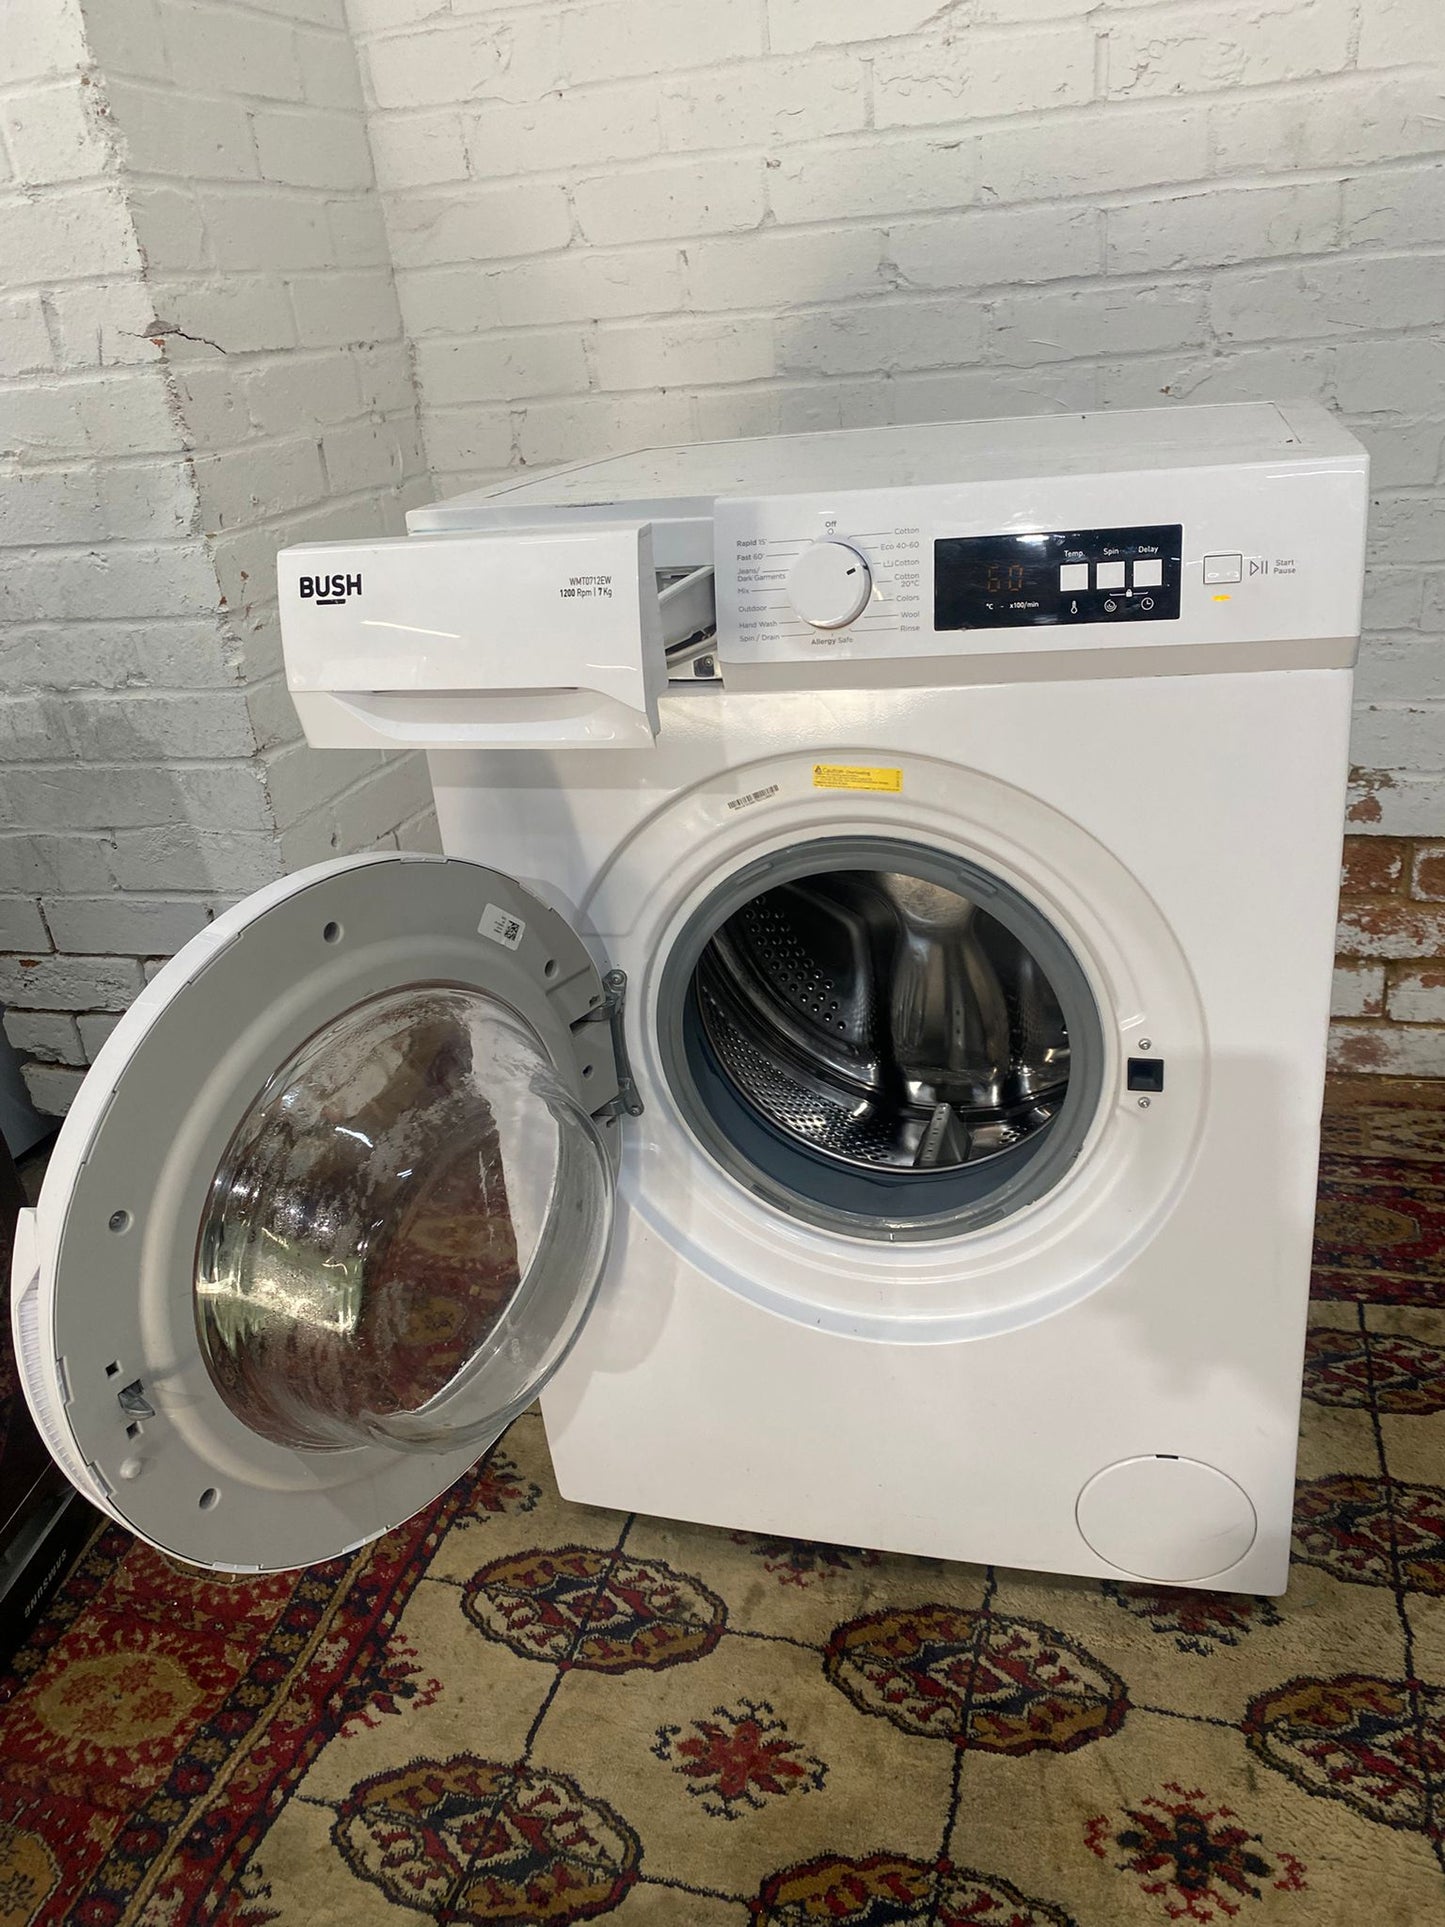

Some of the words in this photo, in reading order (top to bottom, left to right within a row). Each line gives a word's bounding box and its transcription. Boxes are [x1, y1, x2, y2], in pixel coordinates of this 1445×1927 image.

[825, 520, 837, 528] Off
[736, 539, 757, 548] Rapid
[880, 543, 895, 551] Eco
[896, 541, 920, 549] 40-60
[1063, 549, 1085, 558] Temp.
[1103, 547, 1120, 557] Spin
[1138, 545, 1159, 554] Delay
[894, 559, 920, 567] Cotton
[1275, 559, 1295, 567] Start
[1273, 567, 1297, 575] Pause
[737, 574, 753, 582] Dark
[753, 573, 786, 582] Garments
[894, 573, 920, 581] Cotton
[986, 564, 1024, 592] 60
[299, 573, 362, 598] BUSH
[560, 589, 576, 597] 1200
[576, 588, 592, 598] Rpm
[598, 587, 602, 596] 7
[603, 587, 612, 598] Kg
[896, 594, 920, 602] Colors
[738, 604, 768, 613] Outdoor
[1009, 601, 1040, 610] x100/min
[901, 610, 920, 618] Wool
[759, 619, 778, 627] Wash
[900, 624, 921, 632] Rinse
[739, 635, 755, 644] Spin
[762, 632, 781, 641] Drain
[810, 637, 836, 647] Allergy
[837, 635, 853, 644] Safe
